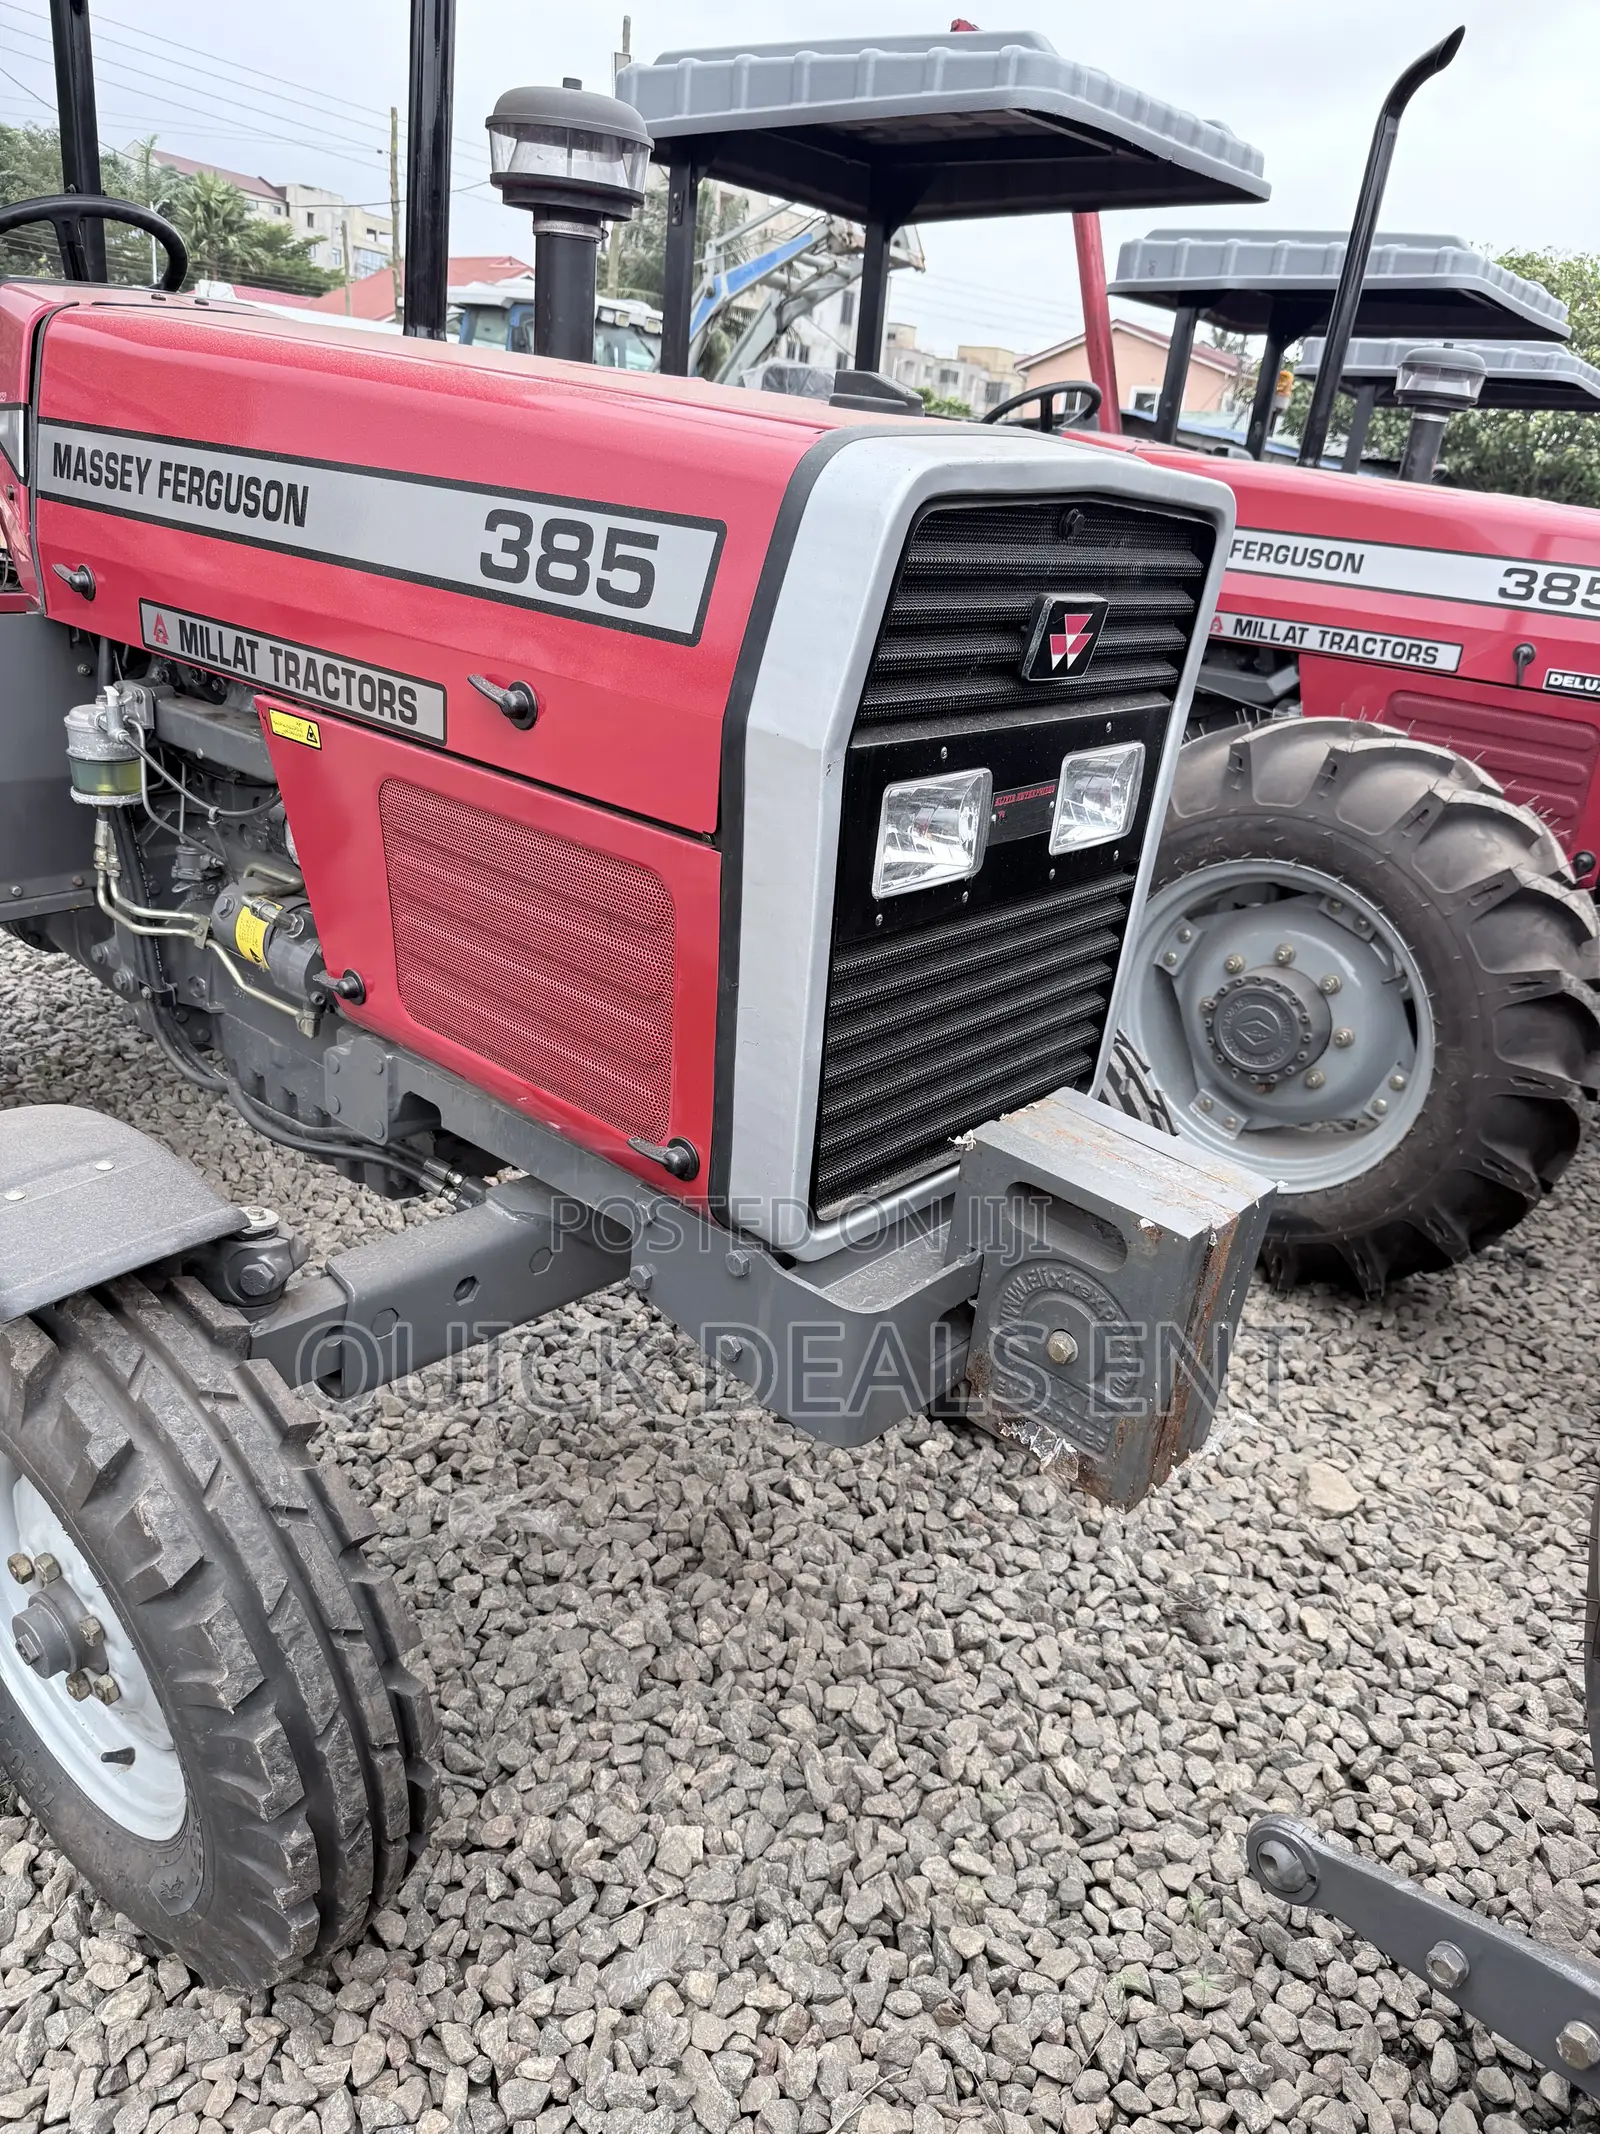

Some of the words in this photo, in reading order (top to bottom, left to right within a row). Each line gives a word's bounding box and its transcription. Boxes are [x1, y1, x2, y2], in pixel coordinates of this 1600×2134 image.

[53, 442, 152, 495] MASSEY
[157, 460, 309, 528] FERGUSON
[480, 508, 660, 609] 385
[1229, 539, 1365, 575] FERGUSON
[1232, 618, 1309, 646] MILLAT
[1317, 629, 1440, 665] TRACTORS
[178, 619, 259, 675] MILLAT
[269, 645, 418, 726] TRACTORS
[1548, 673, 1600, 692] DELU
